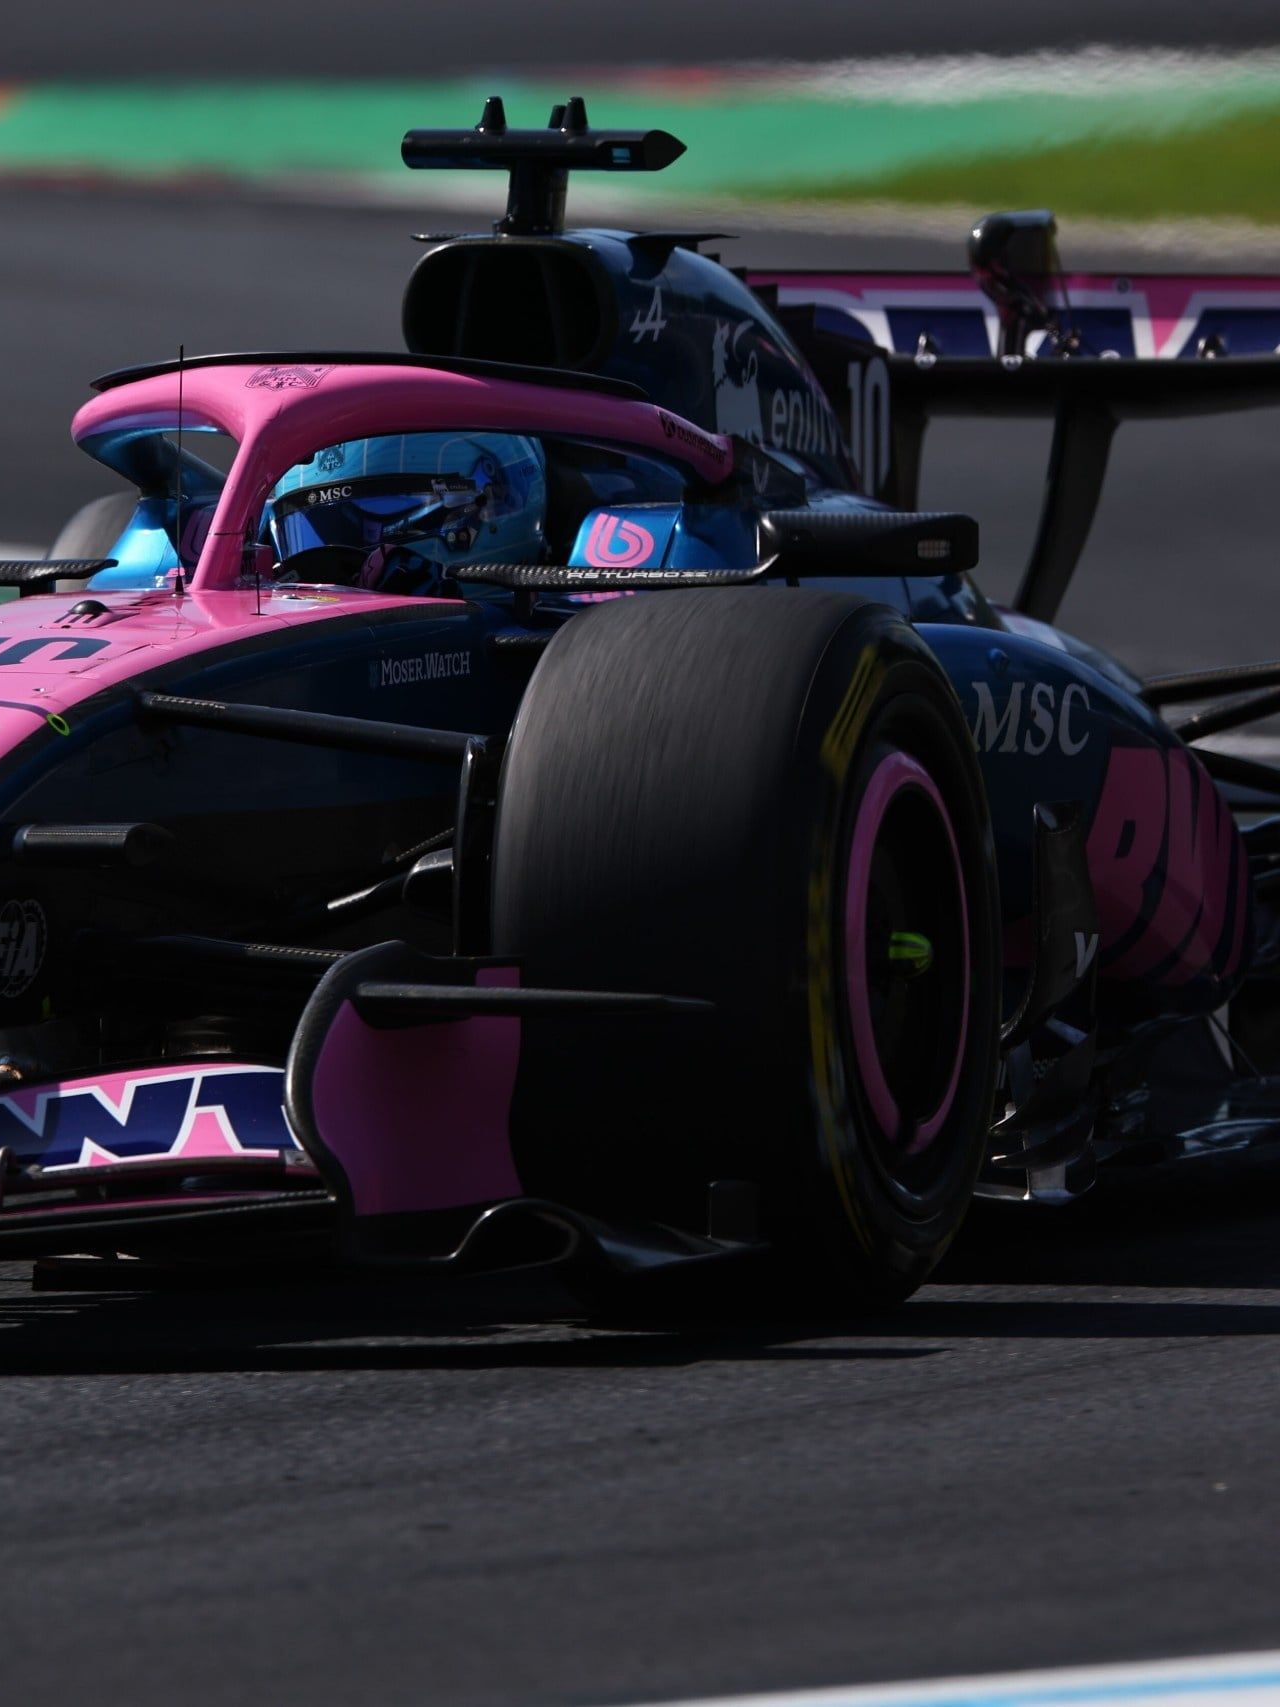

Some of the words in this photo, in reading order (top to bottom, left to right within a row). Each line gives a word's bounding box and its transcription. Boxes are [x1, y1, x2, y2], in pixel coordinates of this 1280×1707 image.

[847, 356, 891, 496] 10
[320, 486, 352, 503] MSC
[971, 681, 1091, 757] MSC
